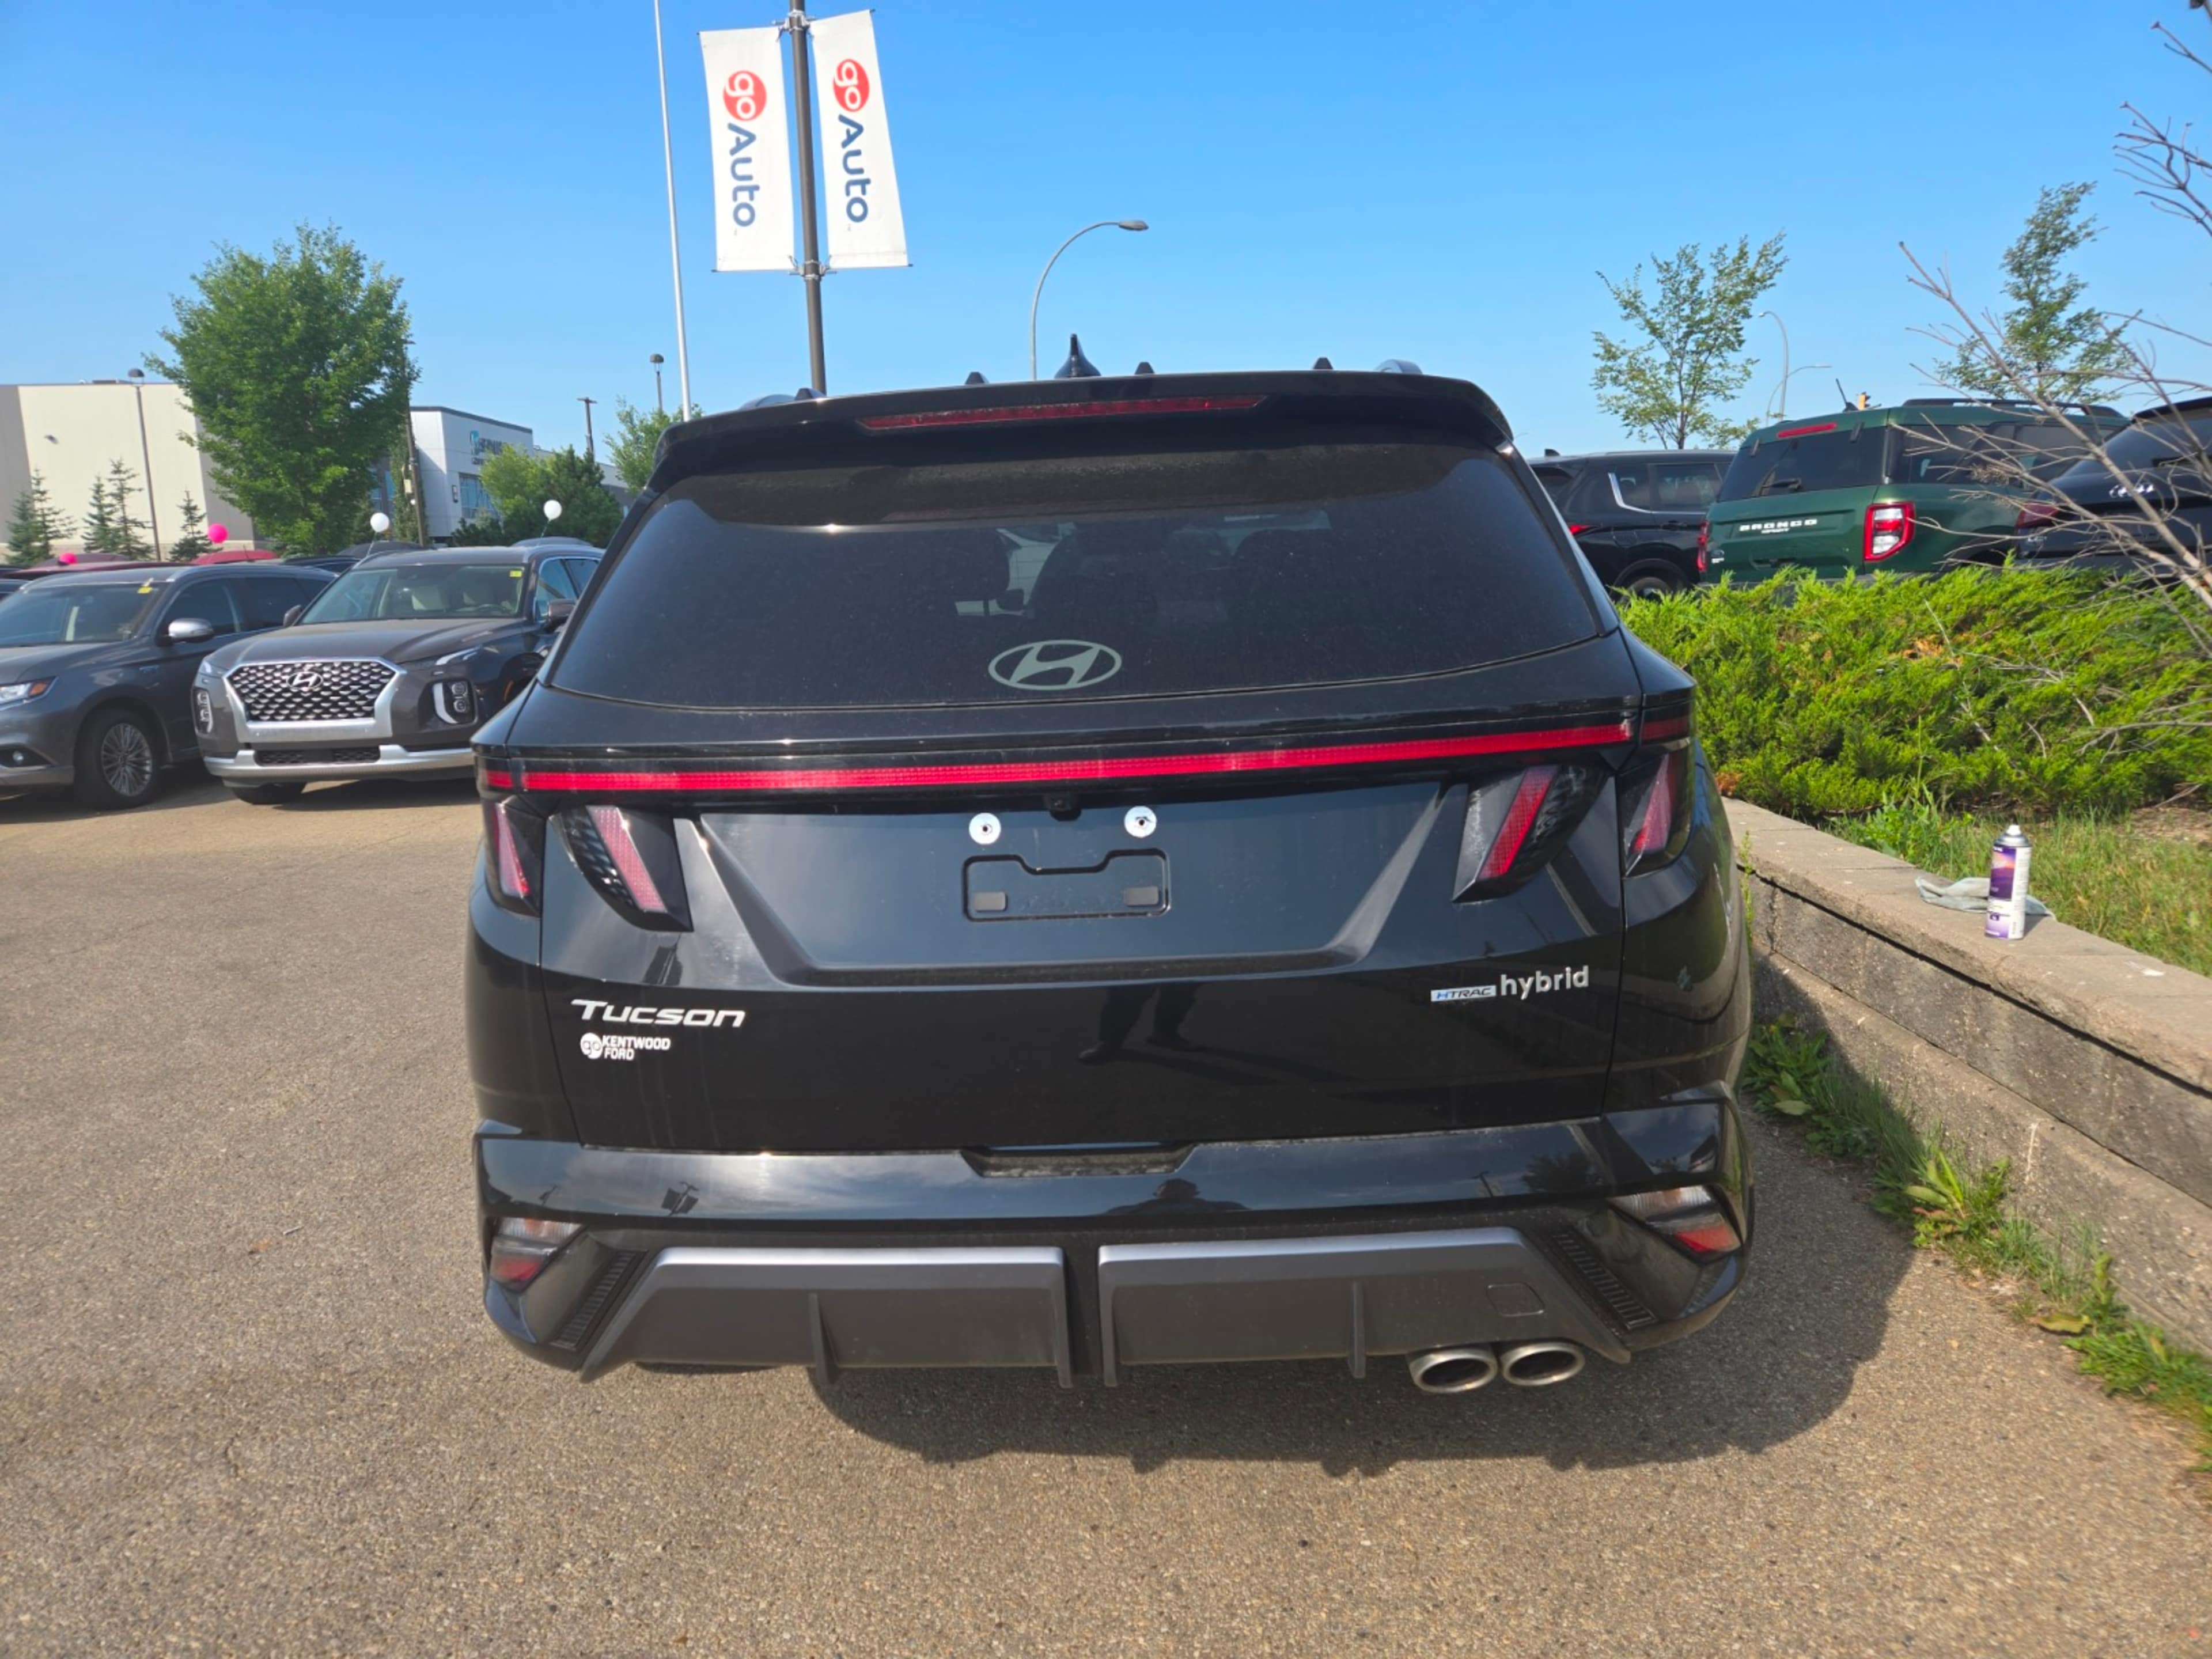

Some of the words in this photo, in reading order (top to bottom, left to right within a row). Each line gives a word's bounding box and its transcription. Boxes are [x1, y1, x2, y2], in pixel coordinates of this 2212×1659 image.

[725, 73, 756, 120] go
[834, 61, 861, 110] go
[728, 123, 760, 227] Auto
[838, 114, 871, 223] Auto
[1436, 987, 1492, 1000] HTRAC
[1500, 965, 1589, 1001] hybrid
[603, 1035, 671, 1051] KENTWOOD
[604, 1048, 635, 1060] FORD
